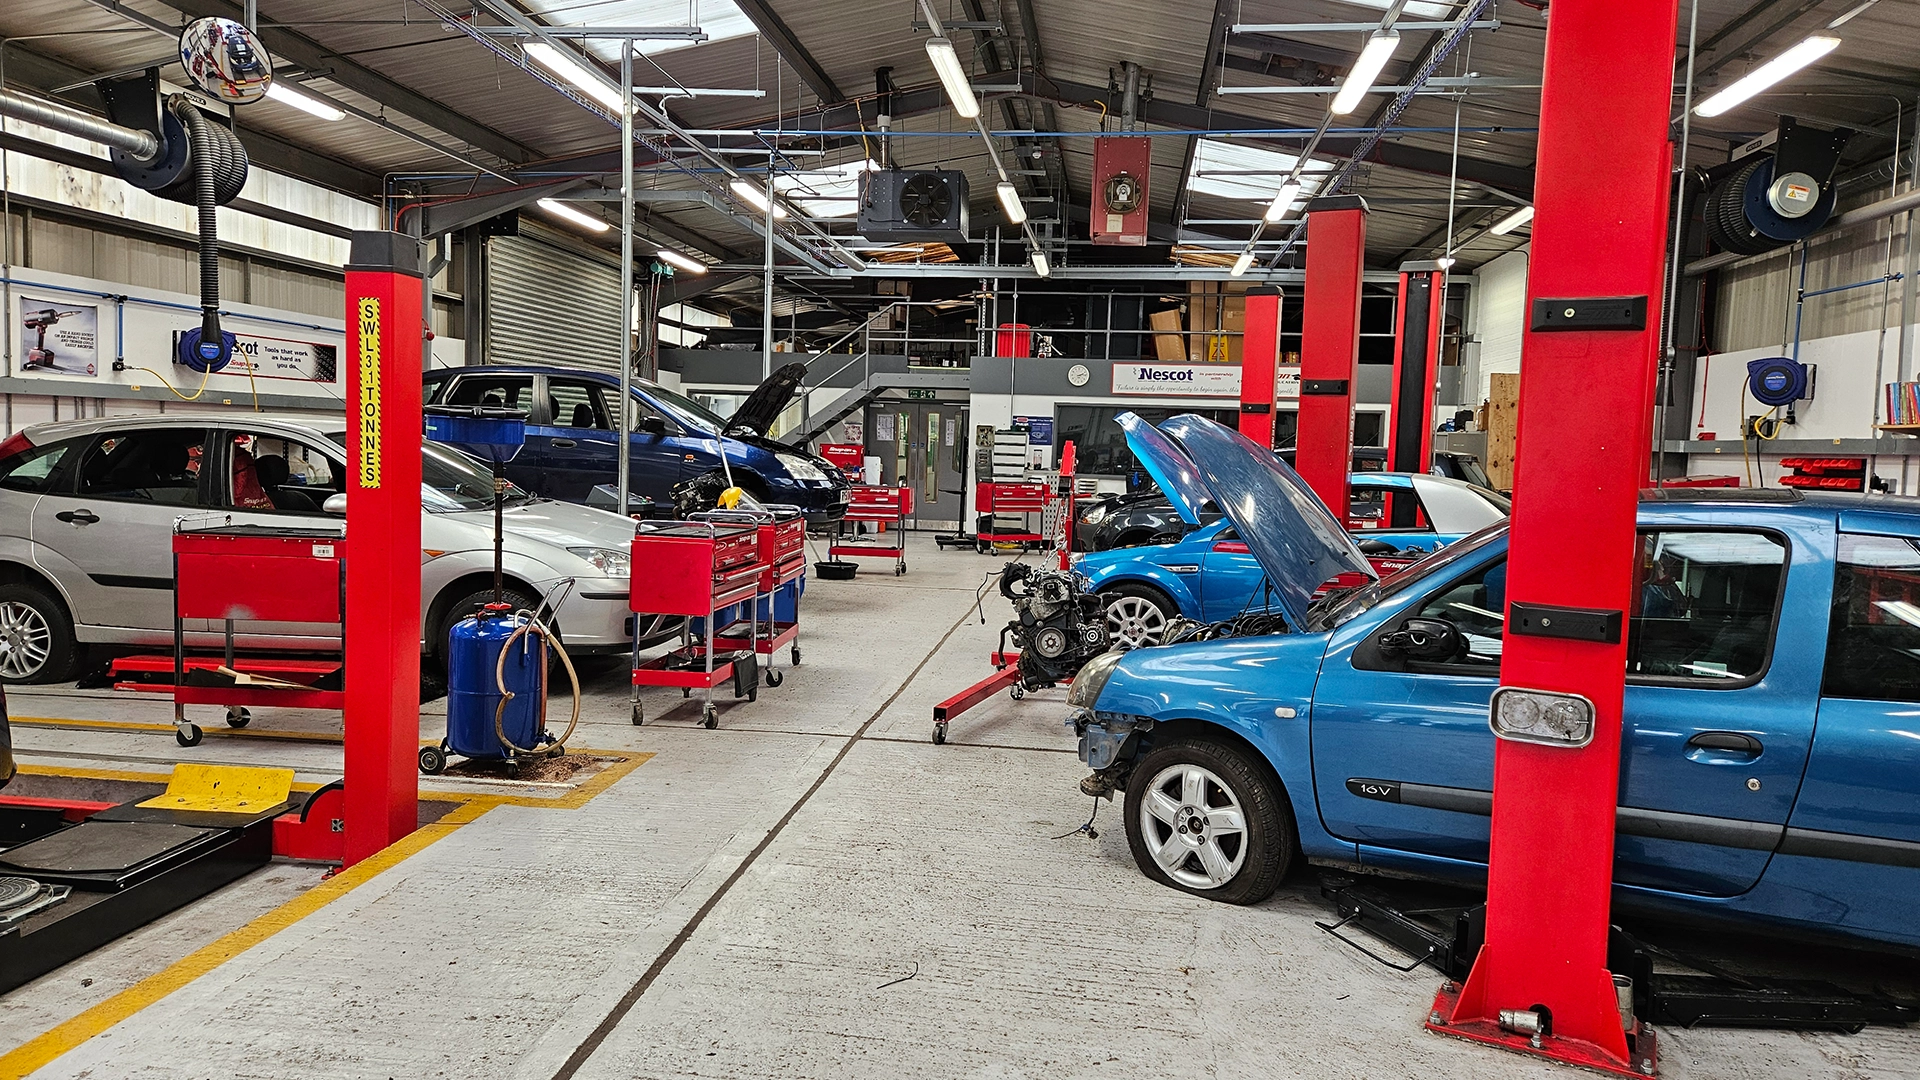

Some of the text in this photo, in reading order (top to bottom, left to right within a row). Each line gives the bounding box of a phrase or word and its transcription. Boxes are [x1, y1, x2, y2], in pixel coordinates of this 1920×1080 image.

[1138, 368, 1194, 381] Nescot
[364, 387, 376, 482] TONNES
[1361, 784, 1390, 796] 16V
